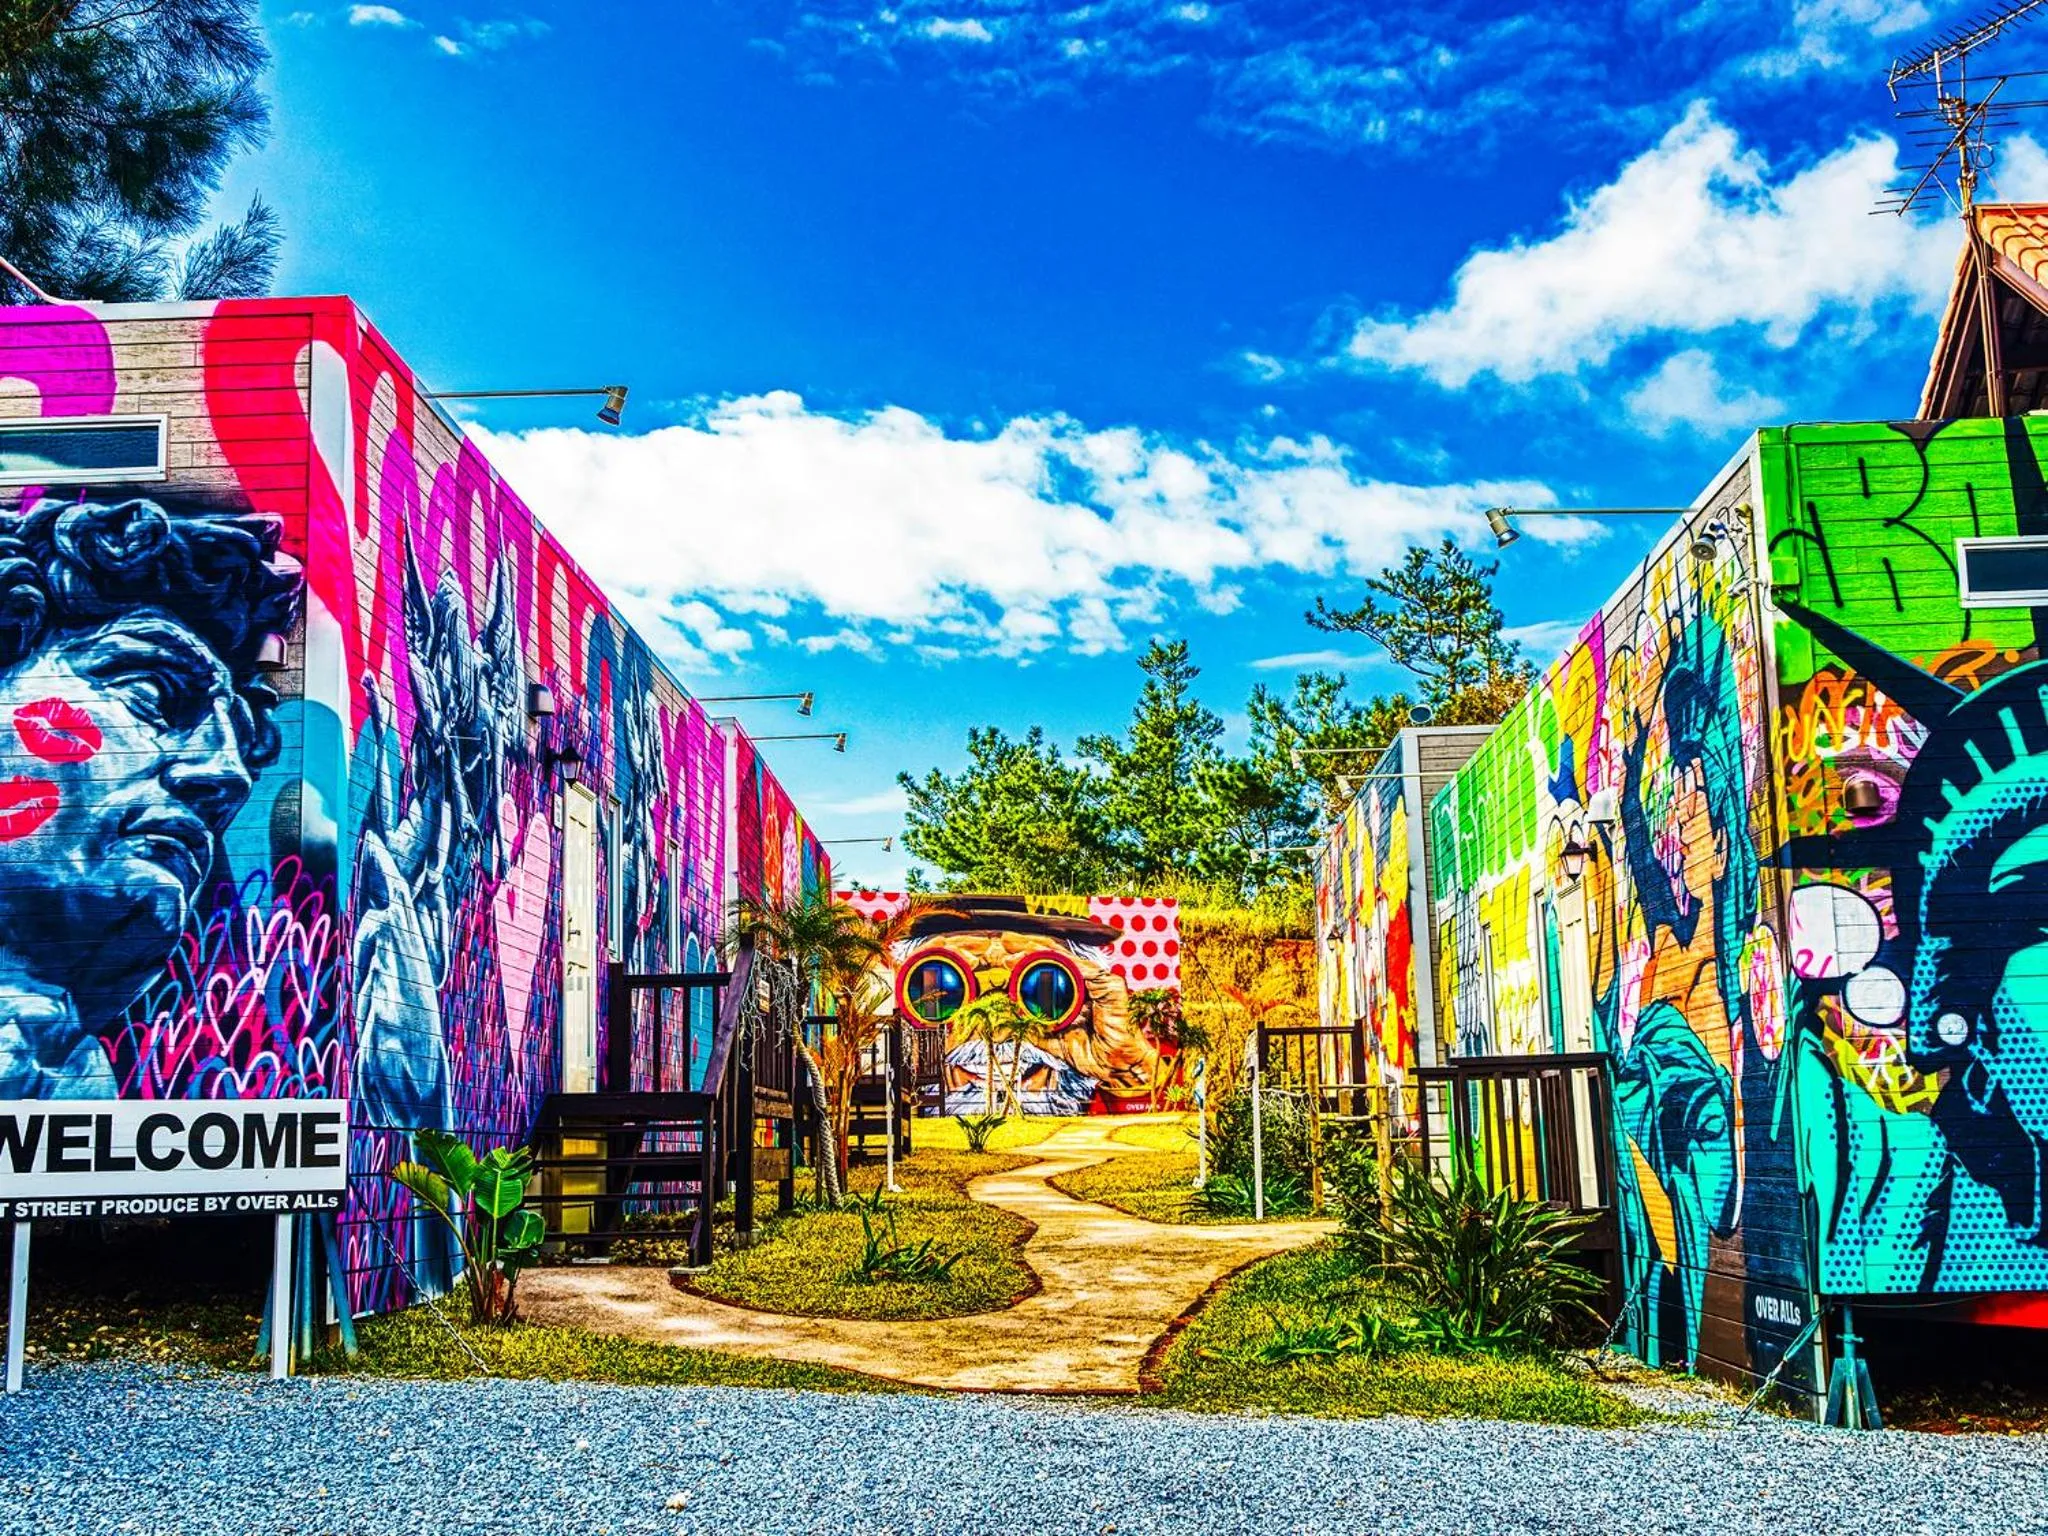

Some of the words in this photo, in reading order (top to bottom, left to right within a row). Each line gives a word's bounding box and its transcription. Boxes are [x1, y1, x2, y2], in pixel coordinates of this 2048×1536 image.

[1126, 1103, 1144, 1111] OVER
[0, 1112, 340, 1173] WELCOME
[15, 1201, 96, 1217] STREET
[101, 1197, 199, 1215] PRODUCE
[204, 1196, 231, 1211] BY
[236, 1194, 289, 1210] OVER
[293, 1194, 338, 1208] ALLs
[1755, 1295, 1779, 1322] OVER
